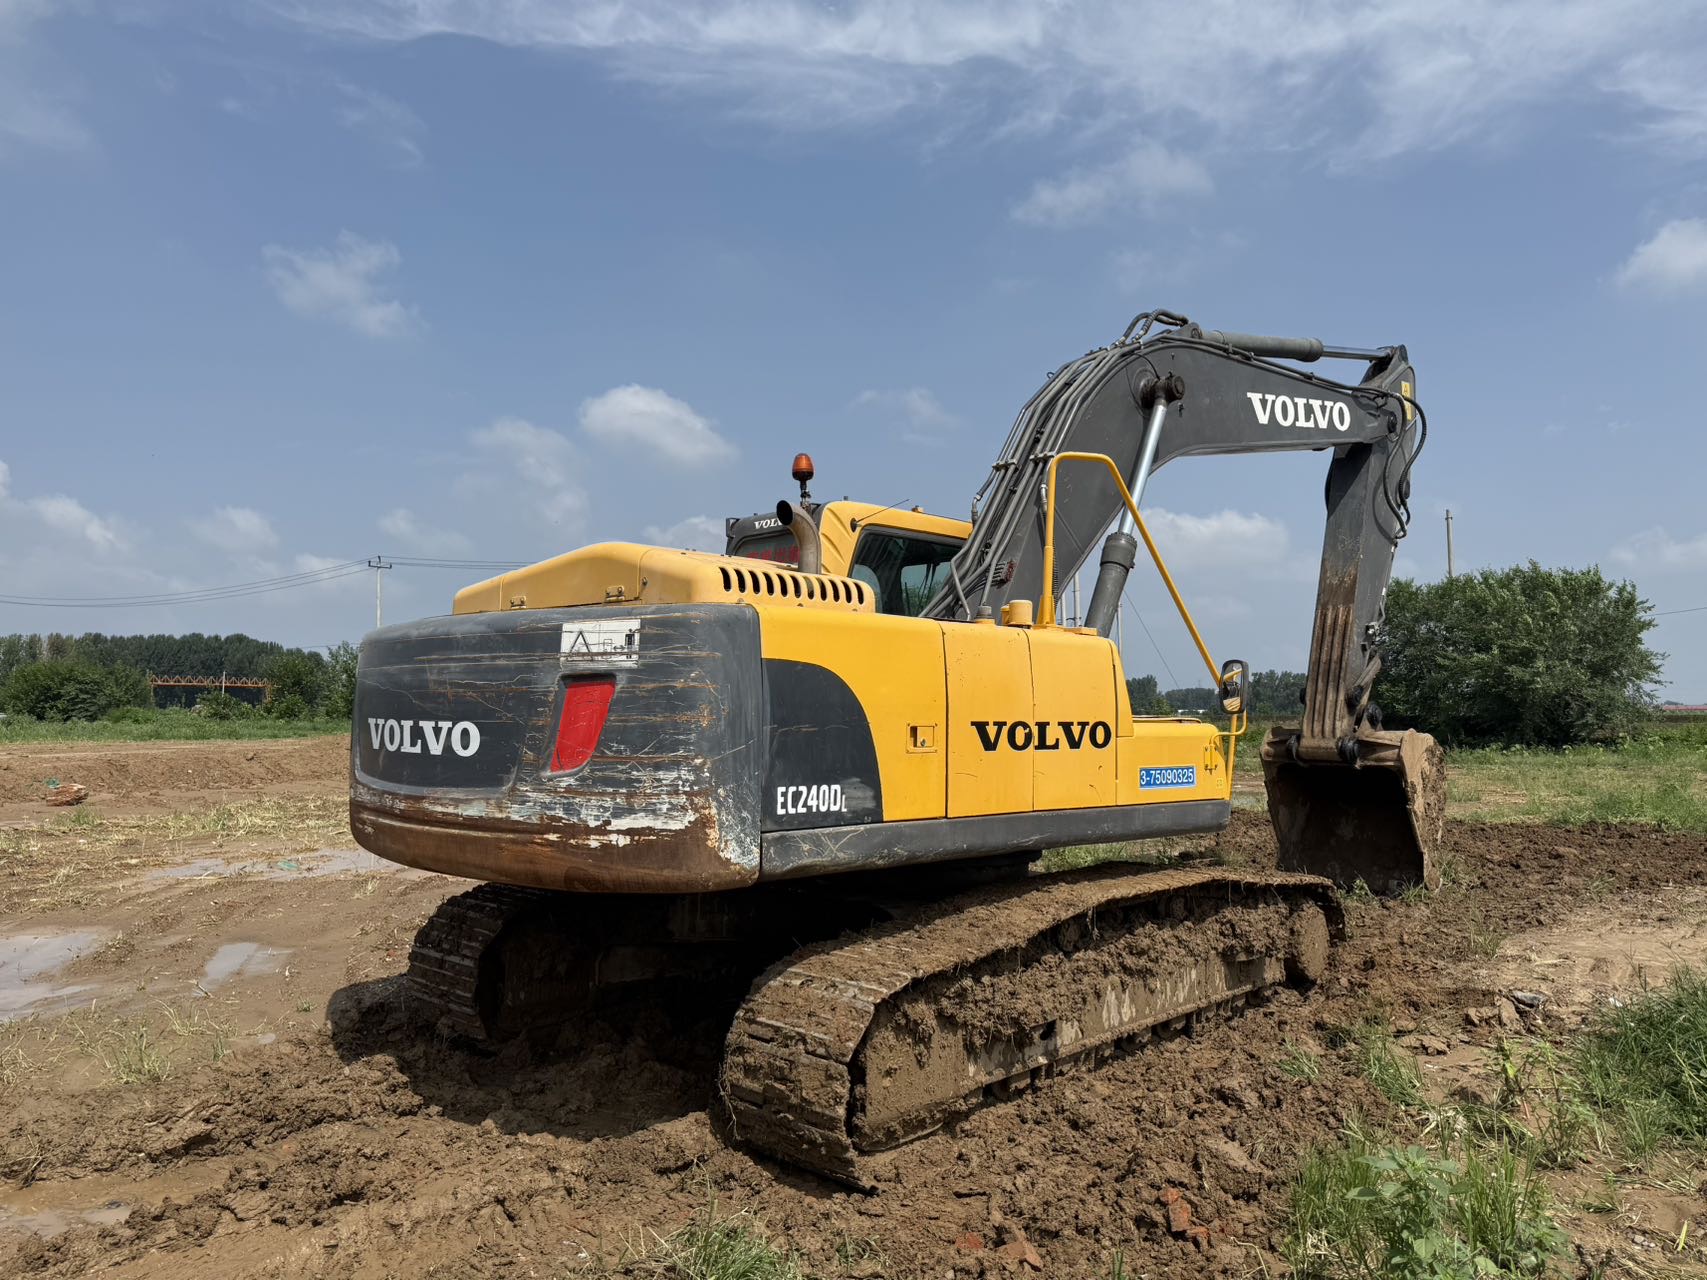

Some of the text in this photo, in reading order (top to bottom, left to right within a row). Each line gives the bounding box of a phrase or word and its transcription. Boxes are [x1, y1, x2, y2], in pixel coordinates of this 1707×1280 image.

[1246, 392, 1351, 432] VOLVO
[753, 517, 784, 530] VOL
[367, 717, 481, 757] VOLVO
[970, 720, 1112, 751] VOLVO
[1140, 768, 1194, 785] 3-75090325
